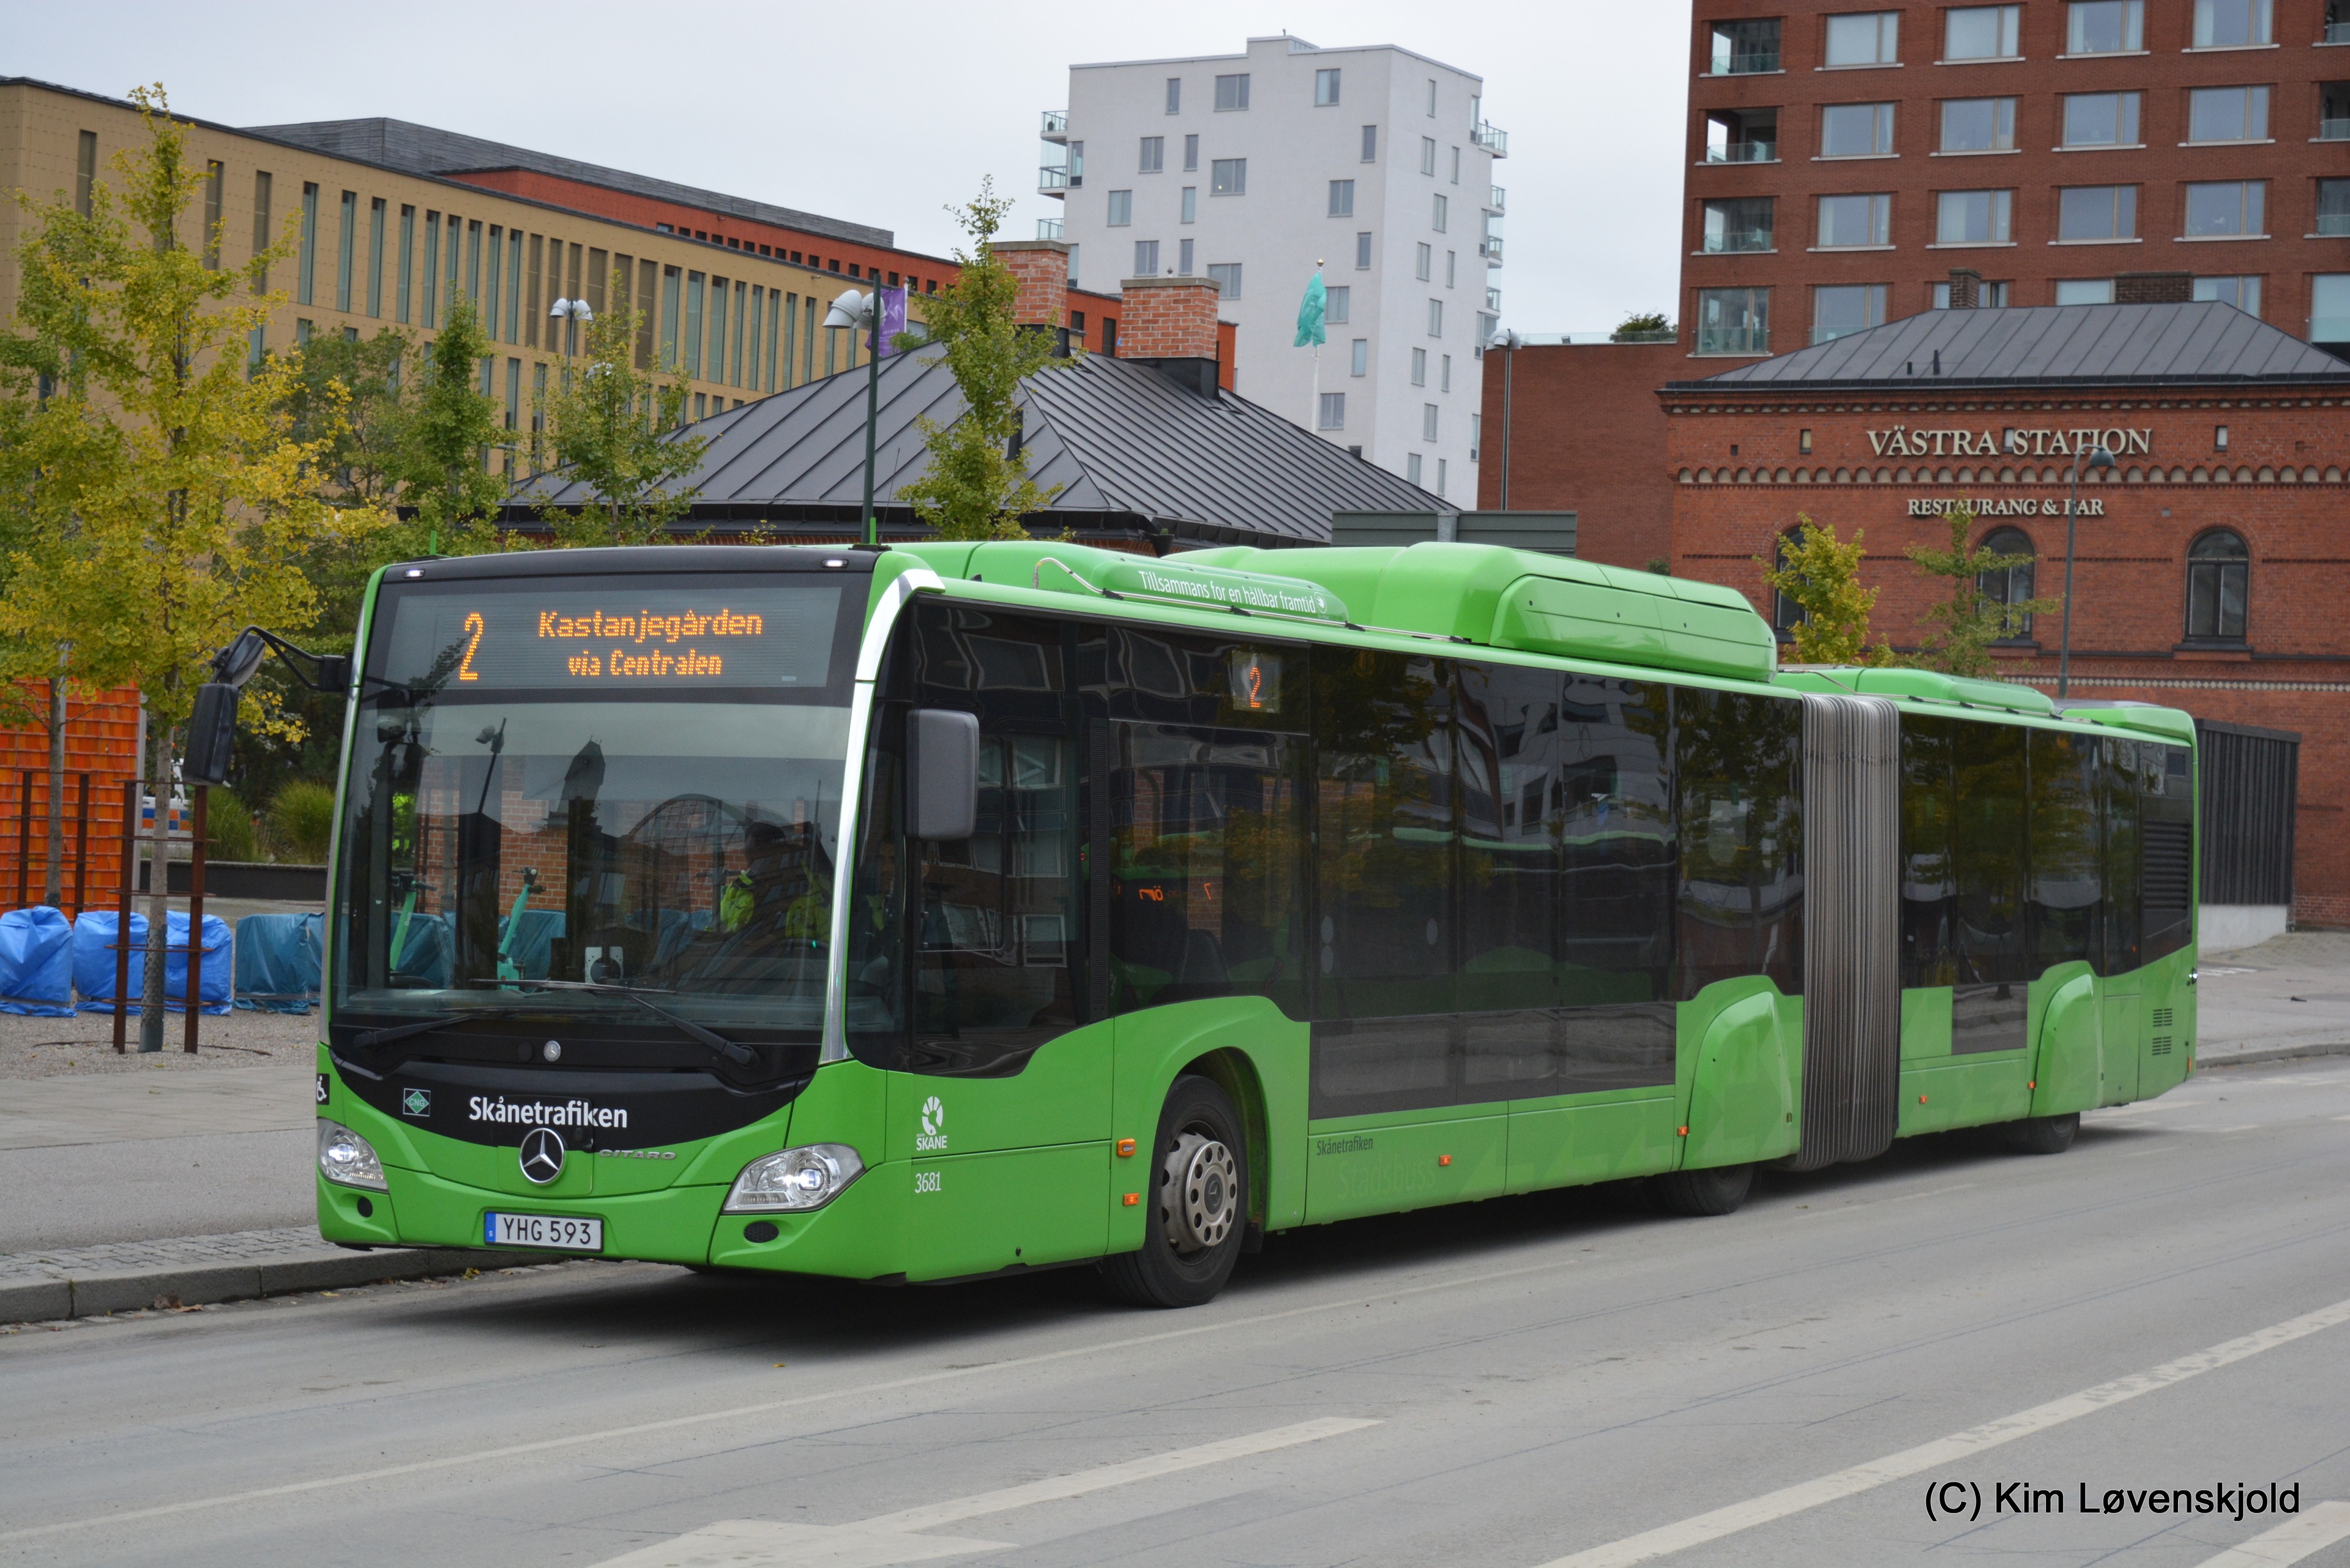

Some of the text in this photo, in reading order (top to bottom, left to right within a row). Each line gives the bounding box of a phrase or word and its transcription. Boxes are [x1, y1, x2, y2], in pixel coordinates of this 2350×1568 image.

[1867, 425, 2152, 455] VÄSTRA STATION
[1908, 499, 2037, 515] RESTAURANG
[2042, 499, 2059, 515] &
[1139, 570, 1210, 599] Tillsammans
[1229, 588, 1242, 604] en
[1242, 586, 1278, 609] hållbar
[1279, 591, 1316, 613] framtid
[539, 609, 763, 643] Kastanjegården
[460, 612, 484, 680] 2
[569, 649, 722, 676] via Centralen
[1250, 666, 1261, 708] 2
[408, 1098, 425, 1107] CNG
[469, 1096, 628, 1128] Skånetrafiken
[599, 1149, 677, 1160] CITARO
[1316, 1135, 1373, 1155] Skånetrafiken
[914, 1171, 941, 1193] 3681
[503, 1217, 591, 1245] YHG 593
